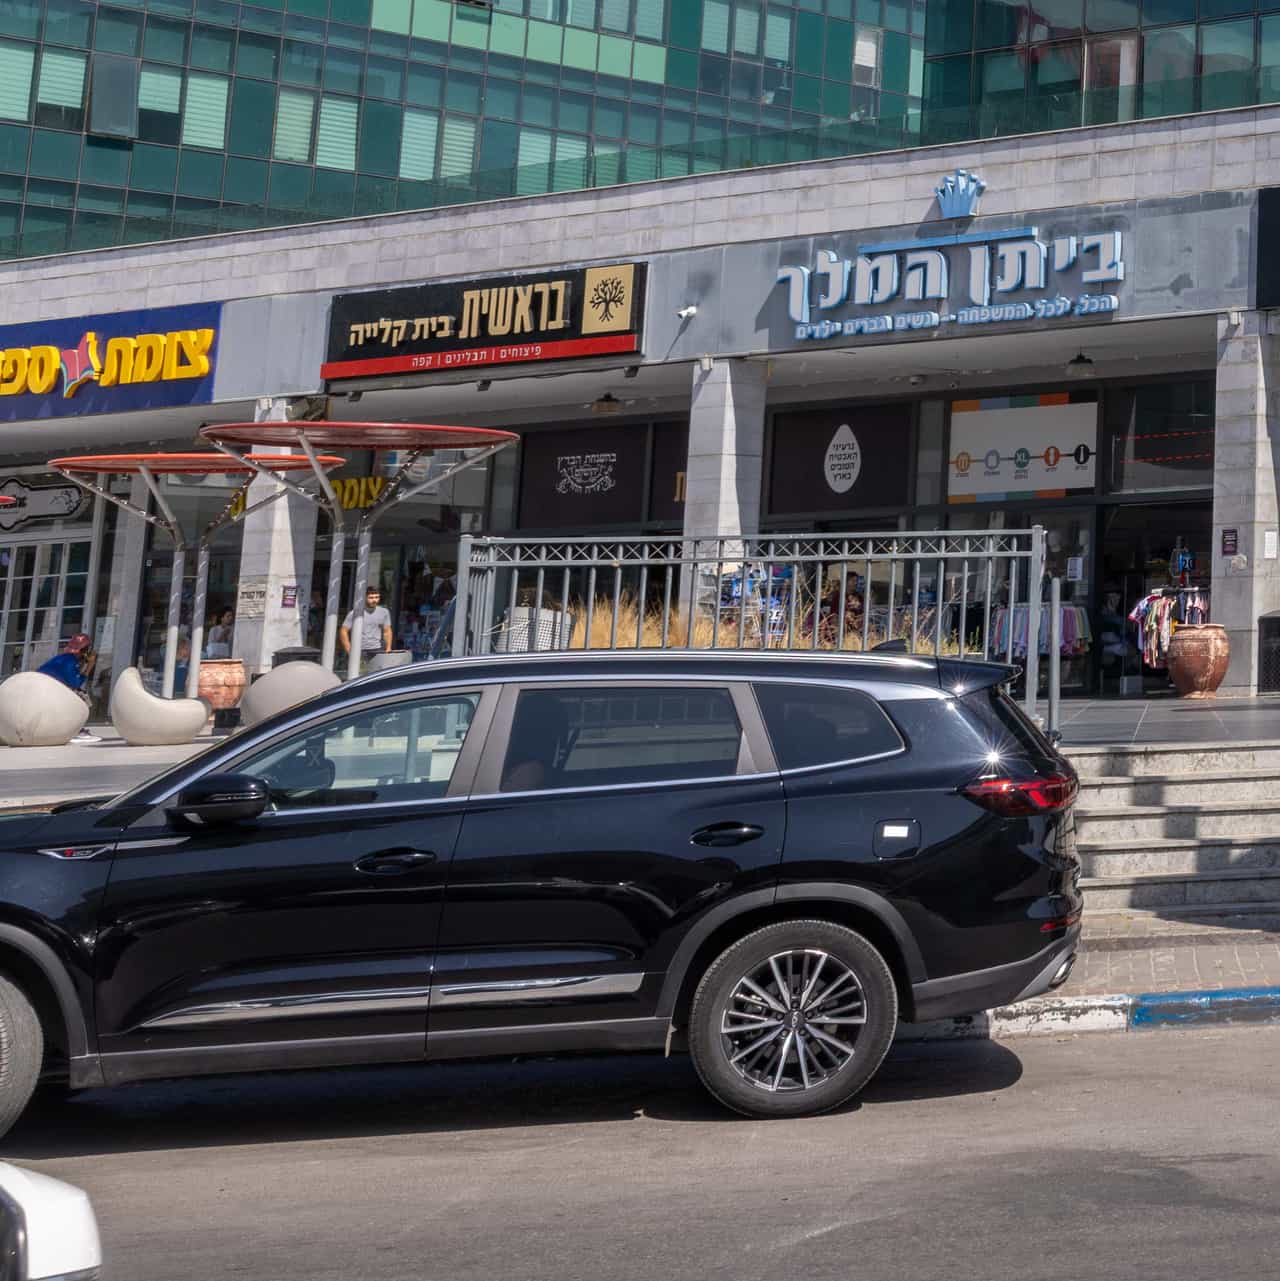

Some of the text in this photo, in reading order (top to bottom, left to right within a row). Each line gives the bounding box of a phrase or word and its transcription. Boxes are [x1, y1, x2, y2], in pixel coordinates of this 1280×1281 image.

[776, 231, 1124, 324] ביתן המלך
[349, 280, 567, 348] בראשית בית קלייה
[894, 311, 940, 329] נשים
[1034, 295, 1071, 318] לכל
[99, 328, 214, 387] צומת
[412, 345, 542, 368] פיצוחים תבלינים קפה
